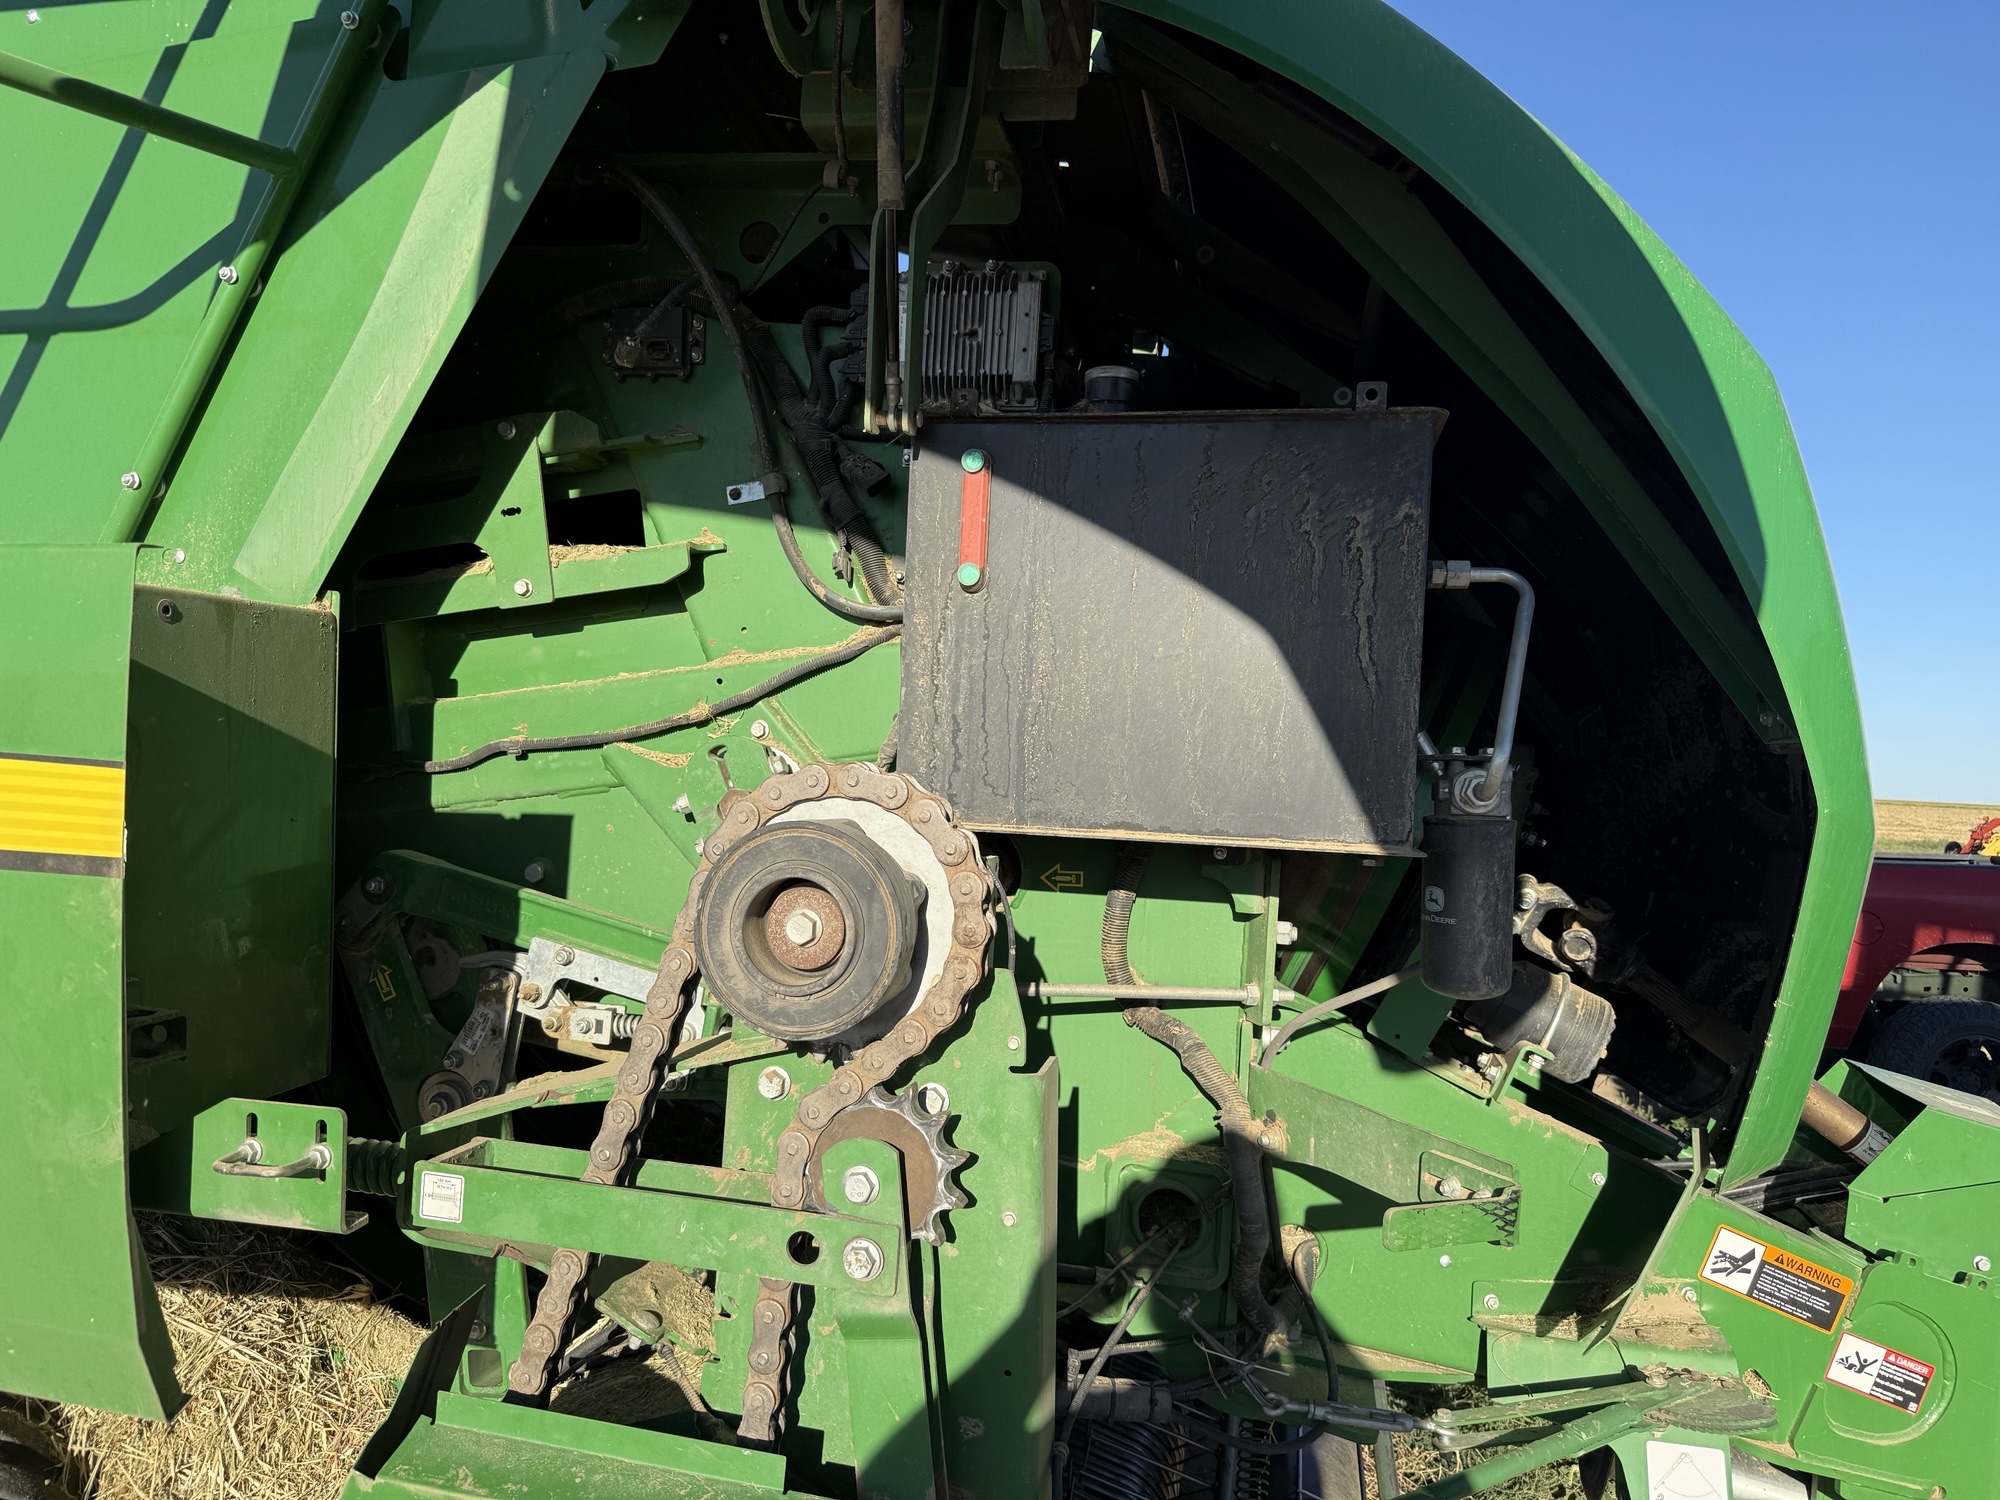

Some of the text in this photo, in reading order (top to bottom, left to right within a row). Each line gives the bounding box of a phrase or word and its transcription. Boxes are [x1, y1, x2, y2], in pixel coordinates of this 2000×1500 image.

[1431, 915, 1457, 925] DEERE
[1786, 1257, 1842, 1289] WARNING
[1896, 1356, 1929, 1375] DANGER
